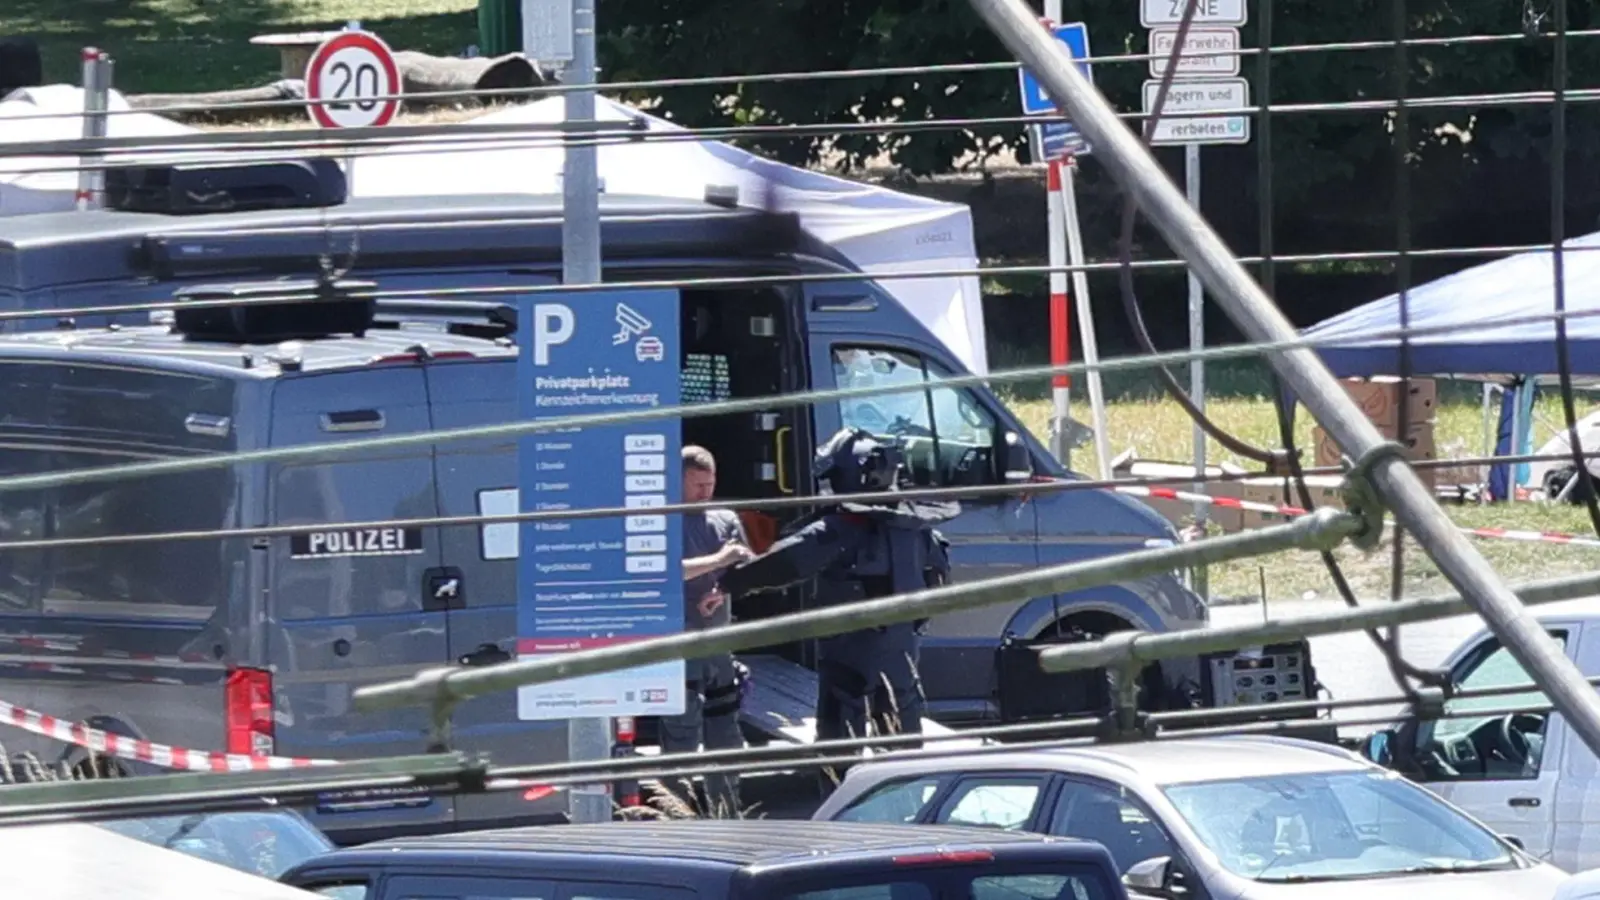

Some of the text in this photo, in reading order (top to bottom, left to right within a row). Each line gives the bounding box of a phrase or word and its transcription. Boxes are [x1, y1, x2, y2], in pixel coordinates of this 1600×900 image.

[1169, 0, 1218, 17] ZNE
[329, 61, 379, 111] 20
[1164, 89, 1232, 104] agern und
[533, 303, 576, 366] P
[535, 375, 631, 391] Privatparkplatz
[309, 528, 405, 553] POLIZEI
